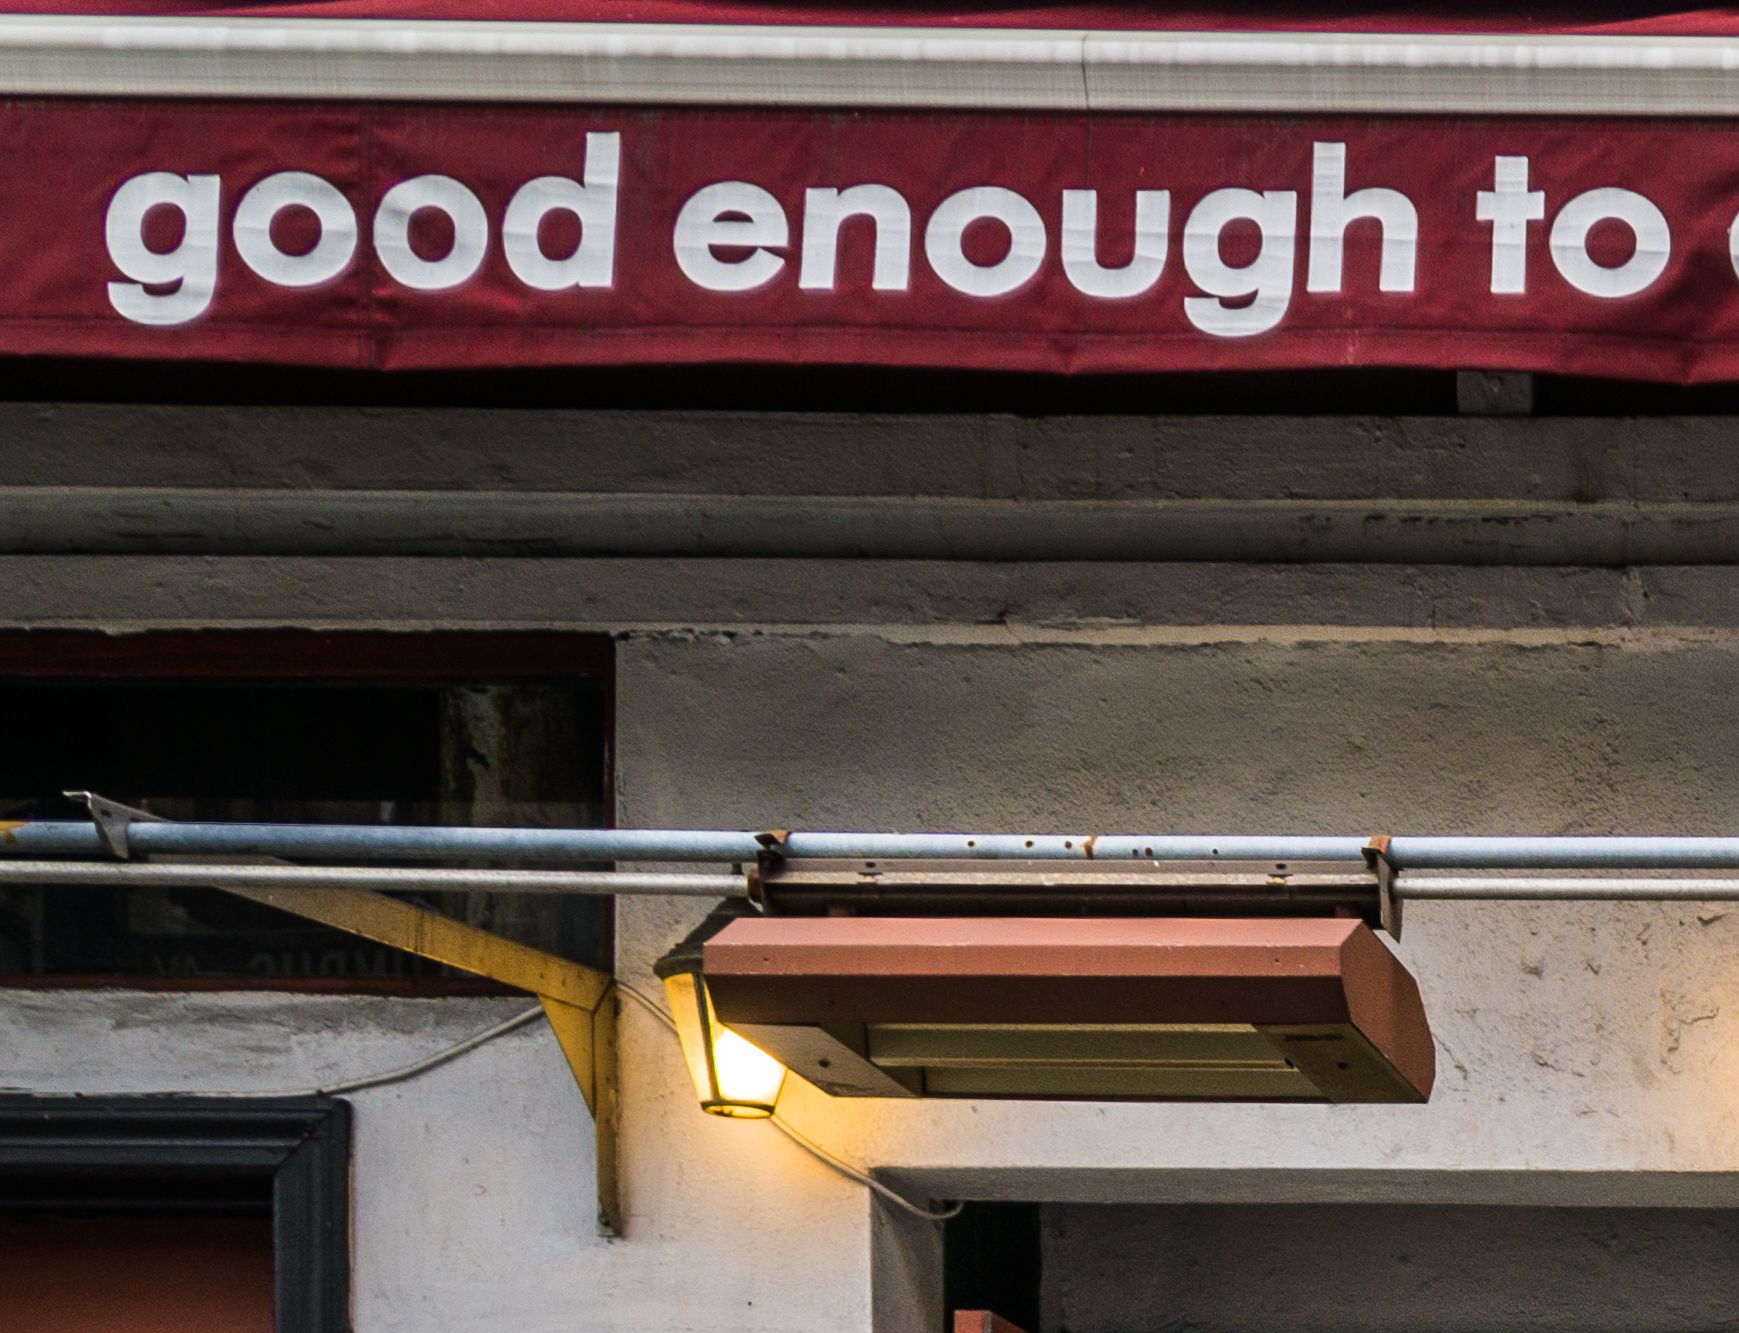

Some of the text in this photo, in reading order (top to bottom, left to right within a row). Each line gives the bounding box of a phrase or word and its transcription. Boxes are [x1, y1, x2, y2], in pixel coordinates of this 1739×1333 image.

[105, 131, 620, 325] good
[673, 141, 1418, 337] enough
[1476, 154, 1670, 298] to
